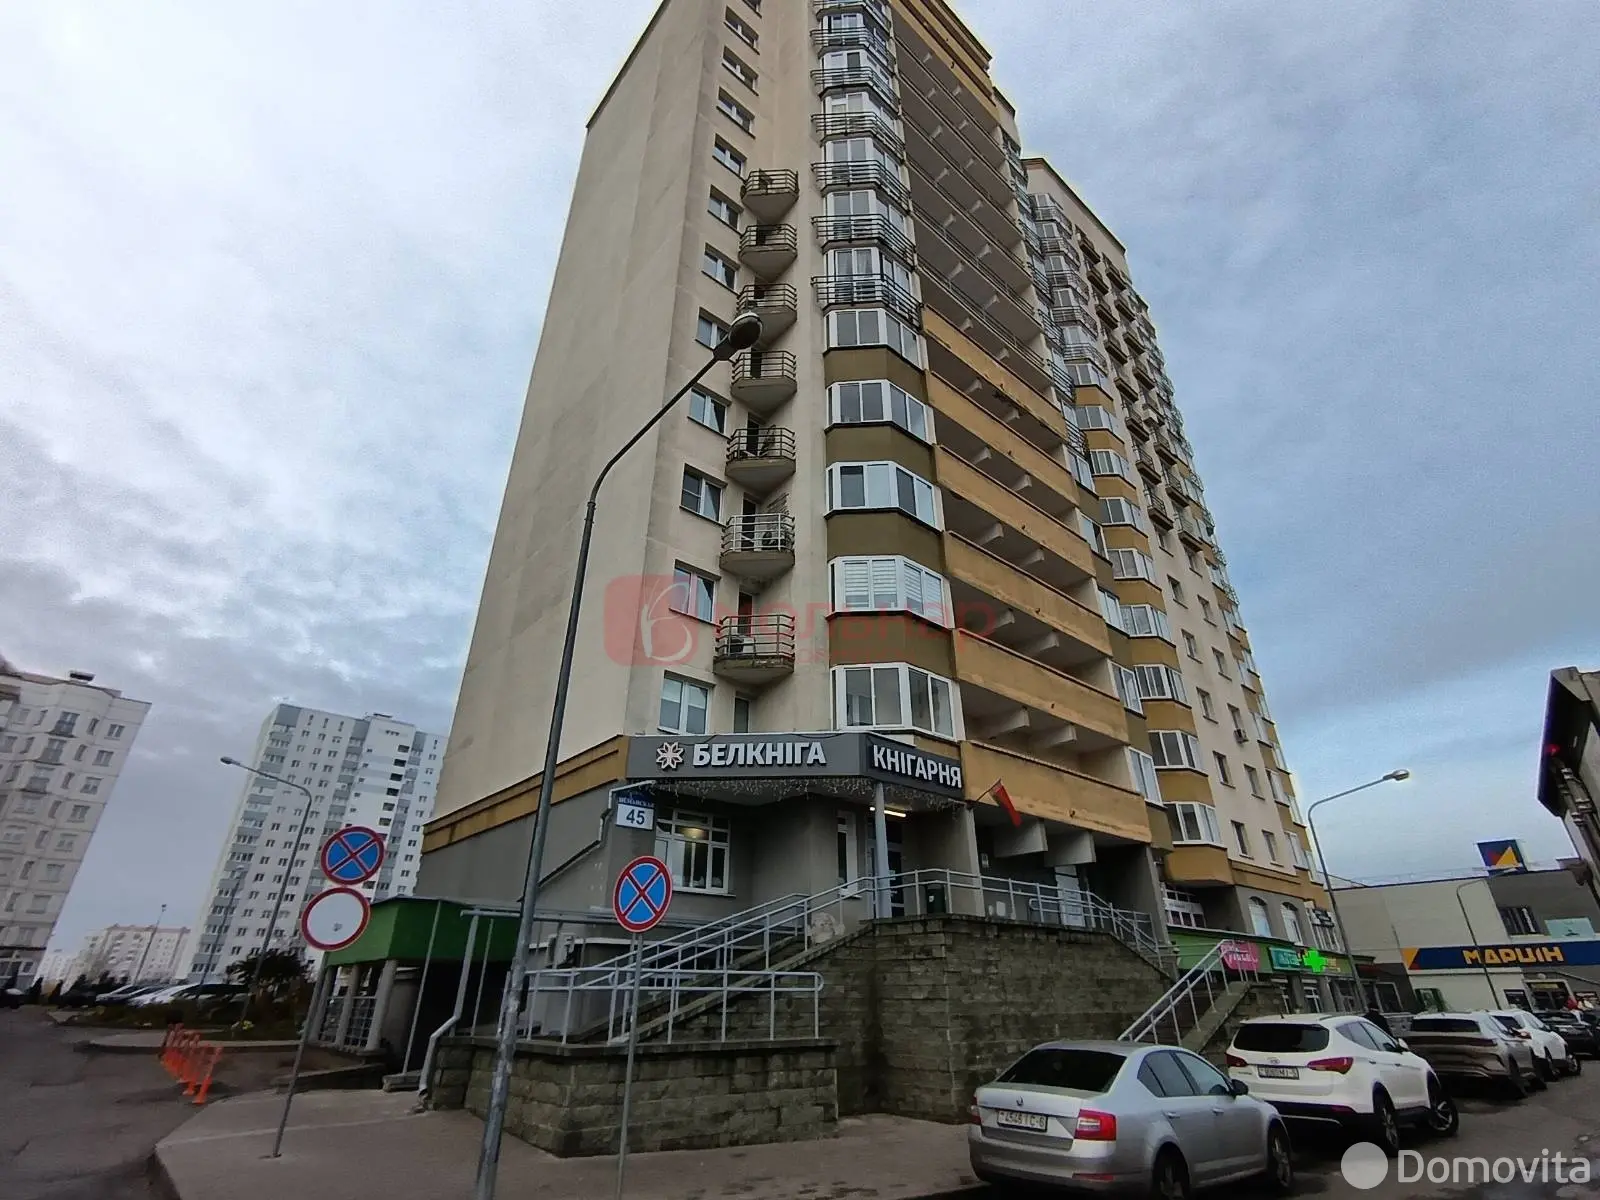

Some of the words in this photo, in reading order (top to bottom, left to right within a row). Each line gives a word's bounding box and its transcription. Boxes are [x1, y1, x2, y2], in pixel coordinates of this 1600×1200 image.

[692, 741, 827, 766] БЕЛКНІГА
[873, 744, 963, 788] КНІГАРНЯ
[626, 809, 645, 825] 45
